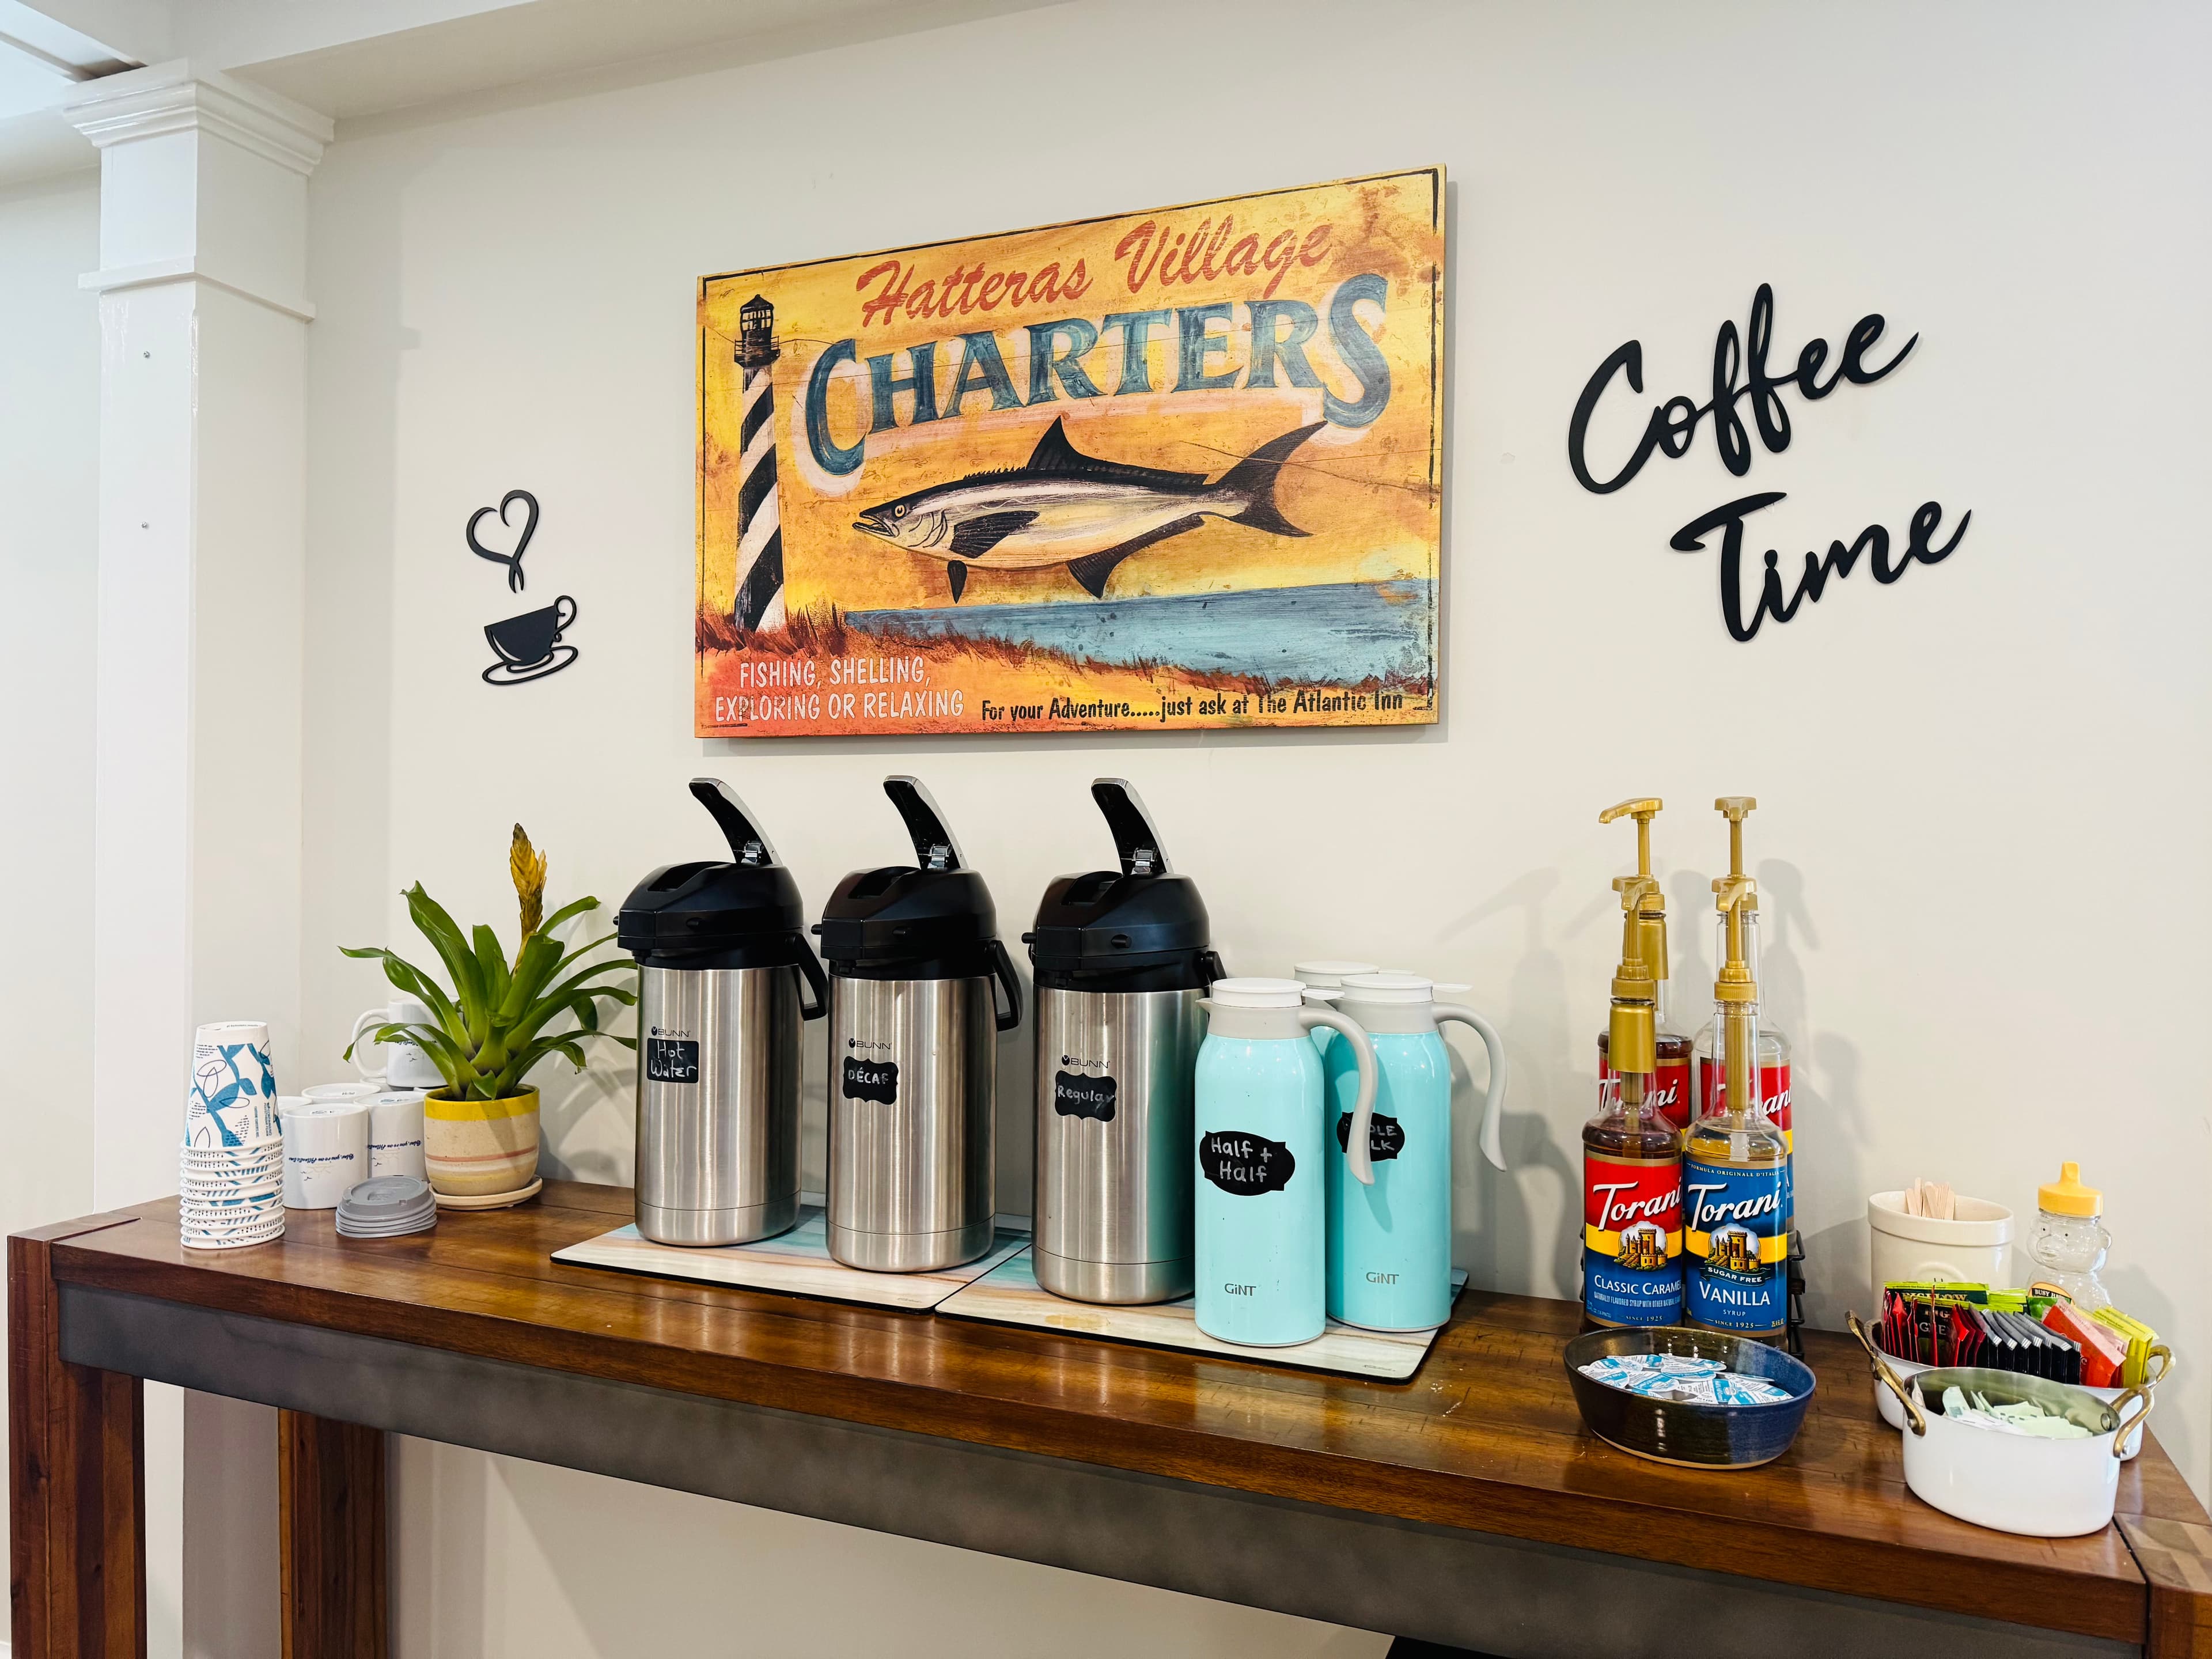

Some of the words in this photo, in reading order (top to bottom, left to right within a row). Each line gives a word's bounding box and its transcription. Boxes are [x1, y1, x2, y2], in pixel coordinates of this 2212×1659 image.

[856, 258, 1093, 327] Hatteras
[1115, 214, 1334, 298] Village
[806, 272, 1392, 476] CHARTERS
[1568, 283, 1919, 494] Coffee
[1670, 492, 1972, 642] Time
[740, 660, 821, 689] FISHING,
[830, 655, 931, 687] SHELLING,
[715, 693, 821, 722] EXPLORING
[830, 692, 857, 719] OR
[864, 689, 964, 719] RELAXING
[982, 700, 1005, 720] For
[1010, 703, 1043, 721] your
[1199, 693, 1226, 715] ask
[1232, 695, 1249, 714] at
[1259, 692, 1286, 713] The
[1293, 689, 1367, 712] Atlantic
[1374, 690, 1403, 710] Inn
[658, 1028, 689, 1037] BUNN
[657, 1040, 685, 1059] Hot
[857, 1040, 891, 1050] BUNN
[651, 1059, 697, 1078] Water
[1071, 1058, 1109, 1069] BUNN
[849, 1067, 888, 1084] DÉCAF
[1058, 1085, 1115, 1105] Regular
[1211, 1137, 1253, 1158] Half
[1220, 1160, 1267, 1183] Half
[1593, 1176, 1681, 1230] Torani
[1688, 1181, 1782, 1232] Torani
[1594, 1275, 1639, 1295] CLASSIC
[1708, 1267, 1737, 1280] SUGAR
[1699, 1281, 1771, 1306] VANILLA
